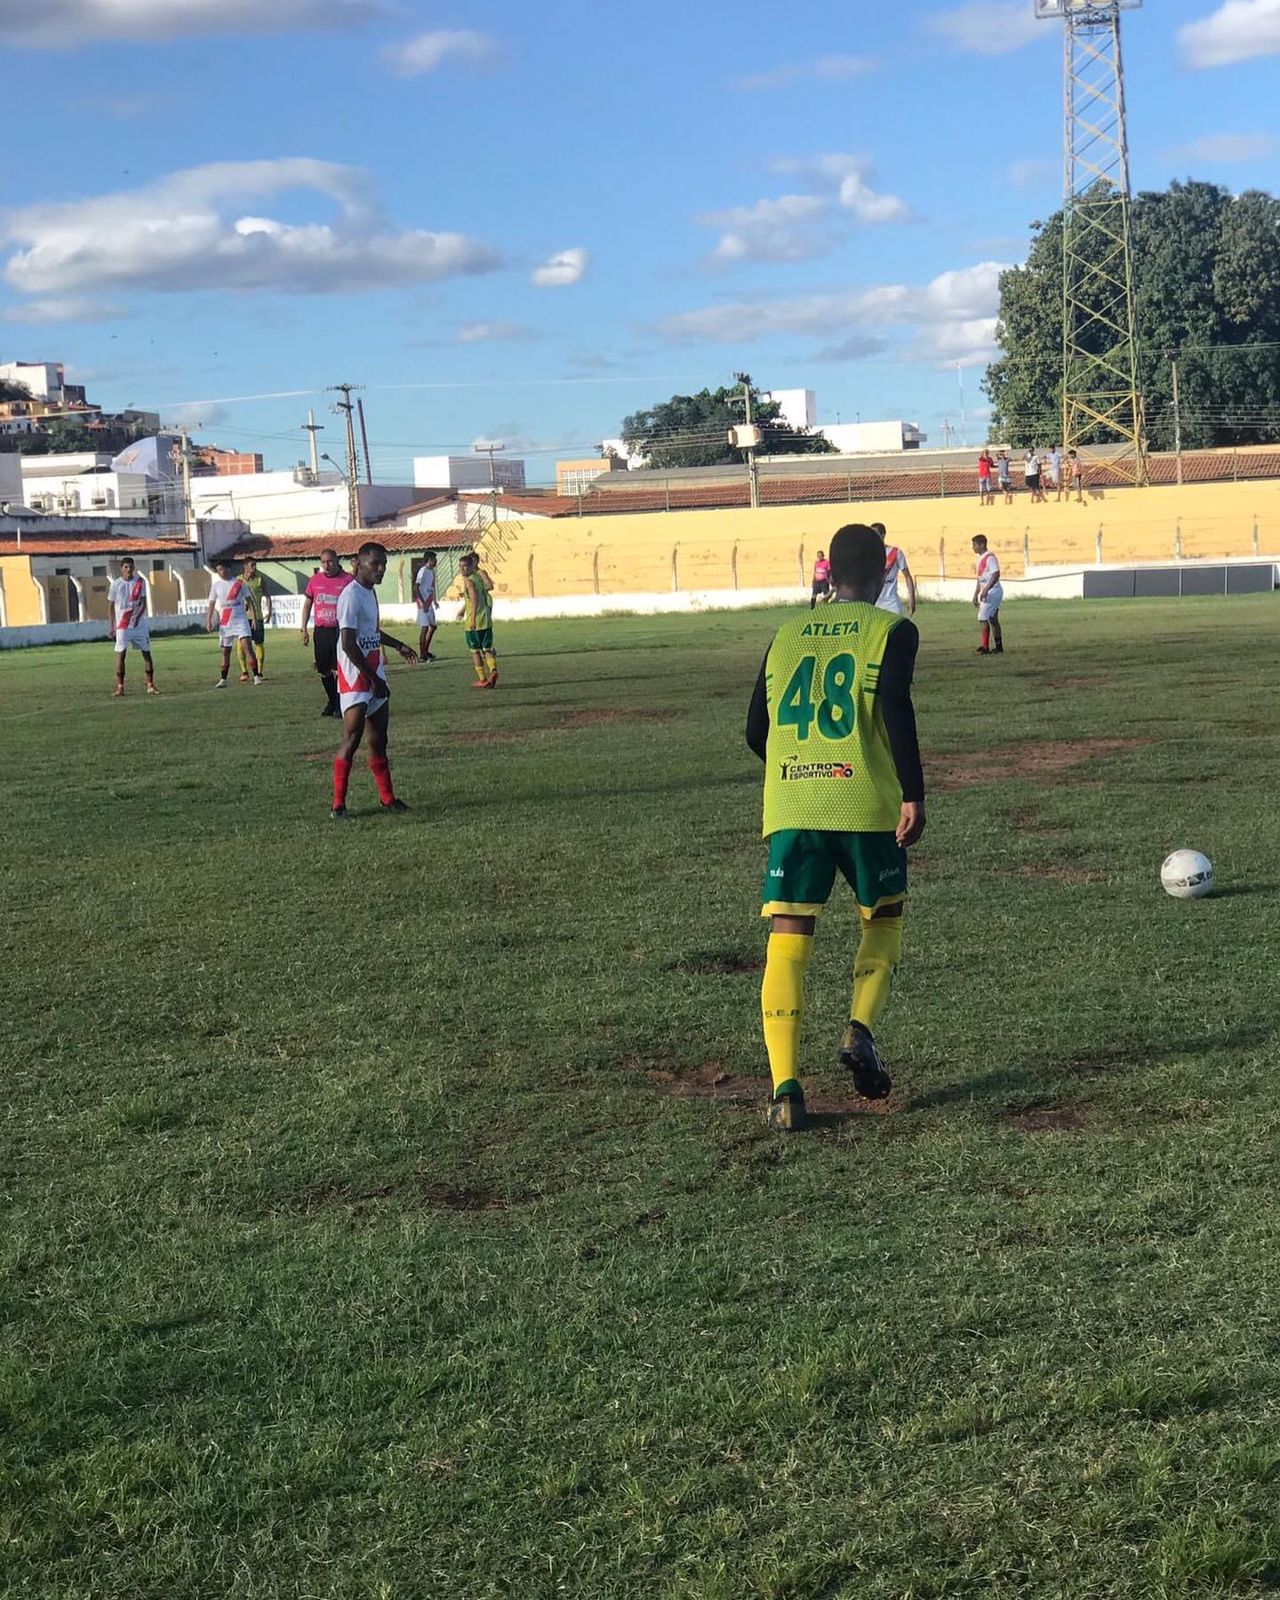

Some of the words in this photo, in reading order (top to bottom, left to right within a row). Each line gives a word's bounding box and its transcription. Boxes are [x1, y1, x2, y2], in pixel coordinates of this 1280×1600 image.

[801, 621, 860, 637] ATLETA
[777, 652, 856, 741] 48
[790, 763, 833, 773] CENTRO
[790, 770, 833, 781] ESPORTIVO
